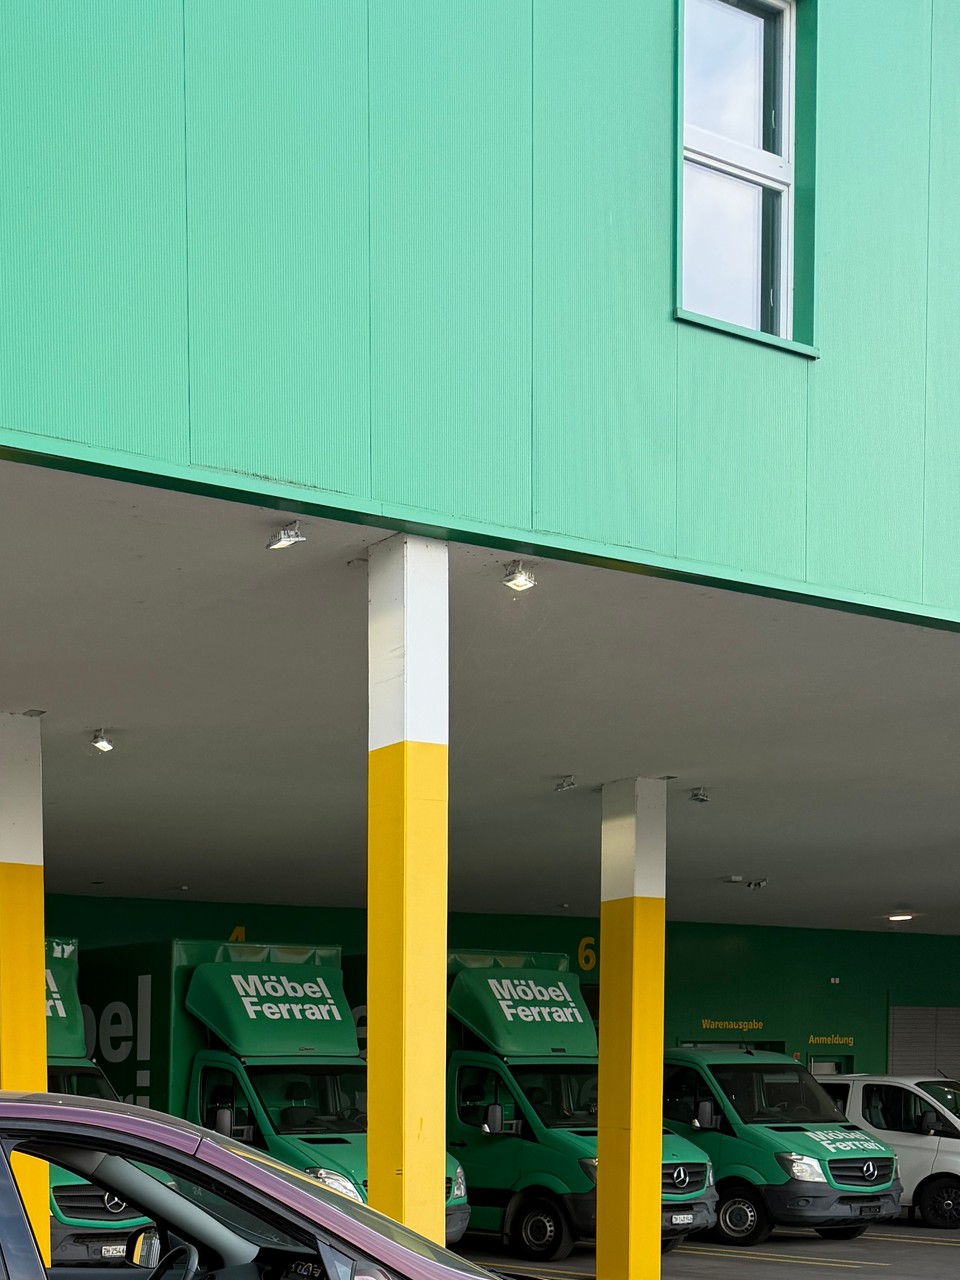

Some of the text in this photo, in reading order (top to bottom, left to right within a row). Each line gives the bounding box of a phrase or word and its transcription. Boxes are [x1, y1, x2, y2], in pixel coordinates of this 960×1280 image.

[578, 936, 596, 971] 6
[231, 974, 332, 998] Möbel
[487, 979, 573, 1002] Möbel
[241, 996, 342, 1021] Ferrari
[499, 1000, 584, 1023] Ferrari
[701, 1019, 764, 1031] Warenausgabe
[808, 1034, 854, 1046] Anmeldung
[804, 1129, 875, 1143] Möbel
[820, 1139, 886, 1153] Ferrari
